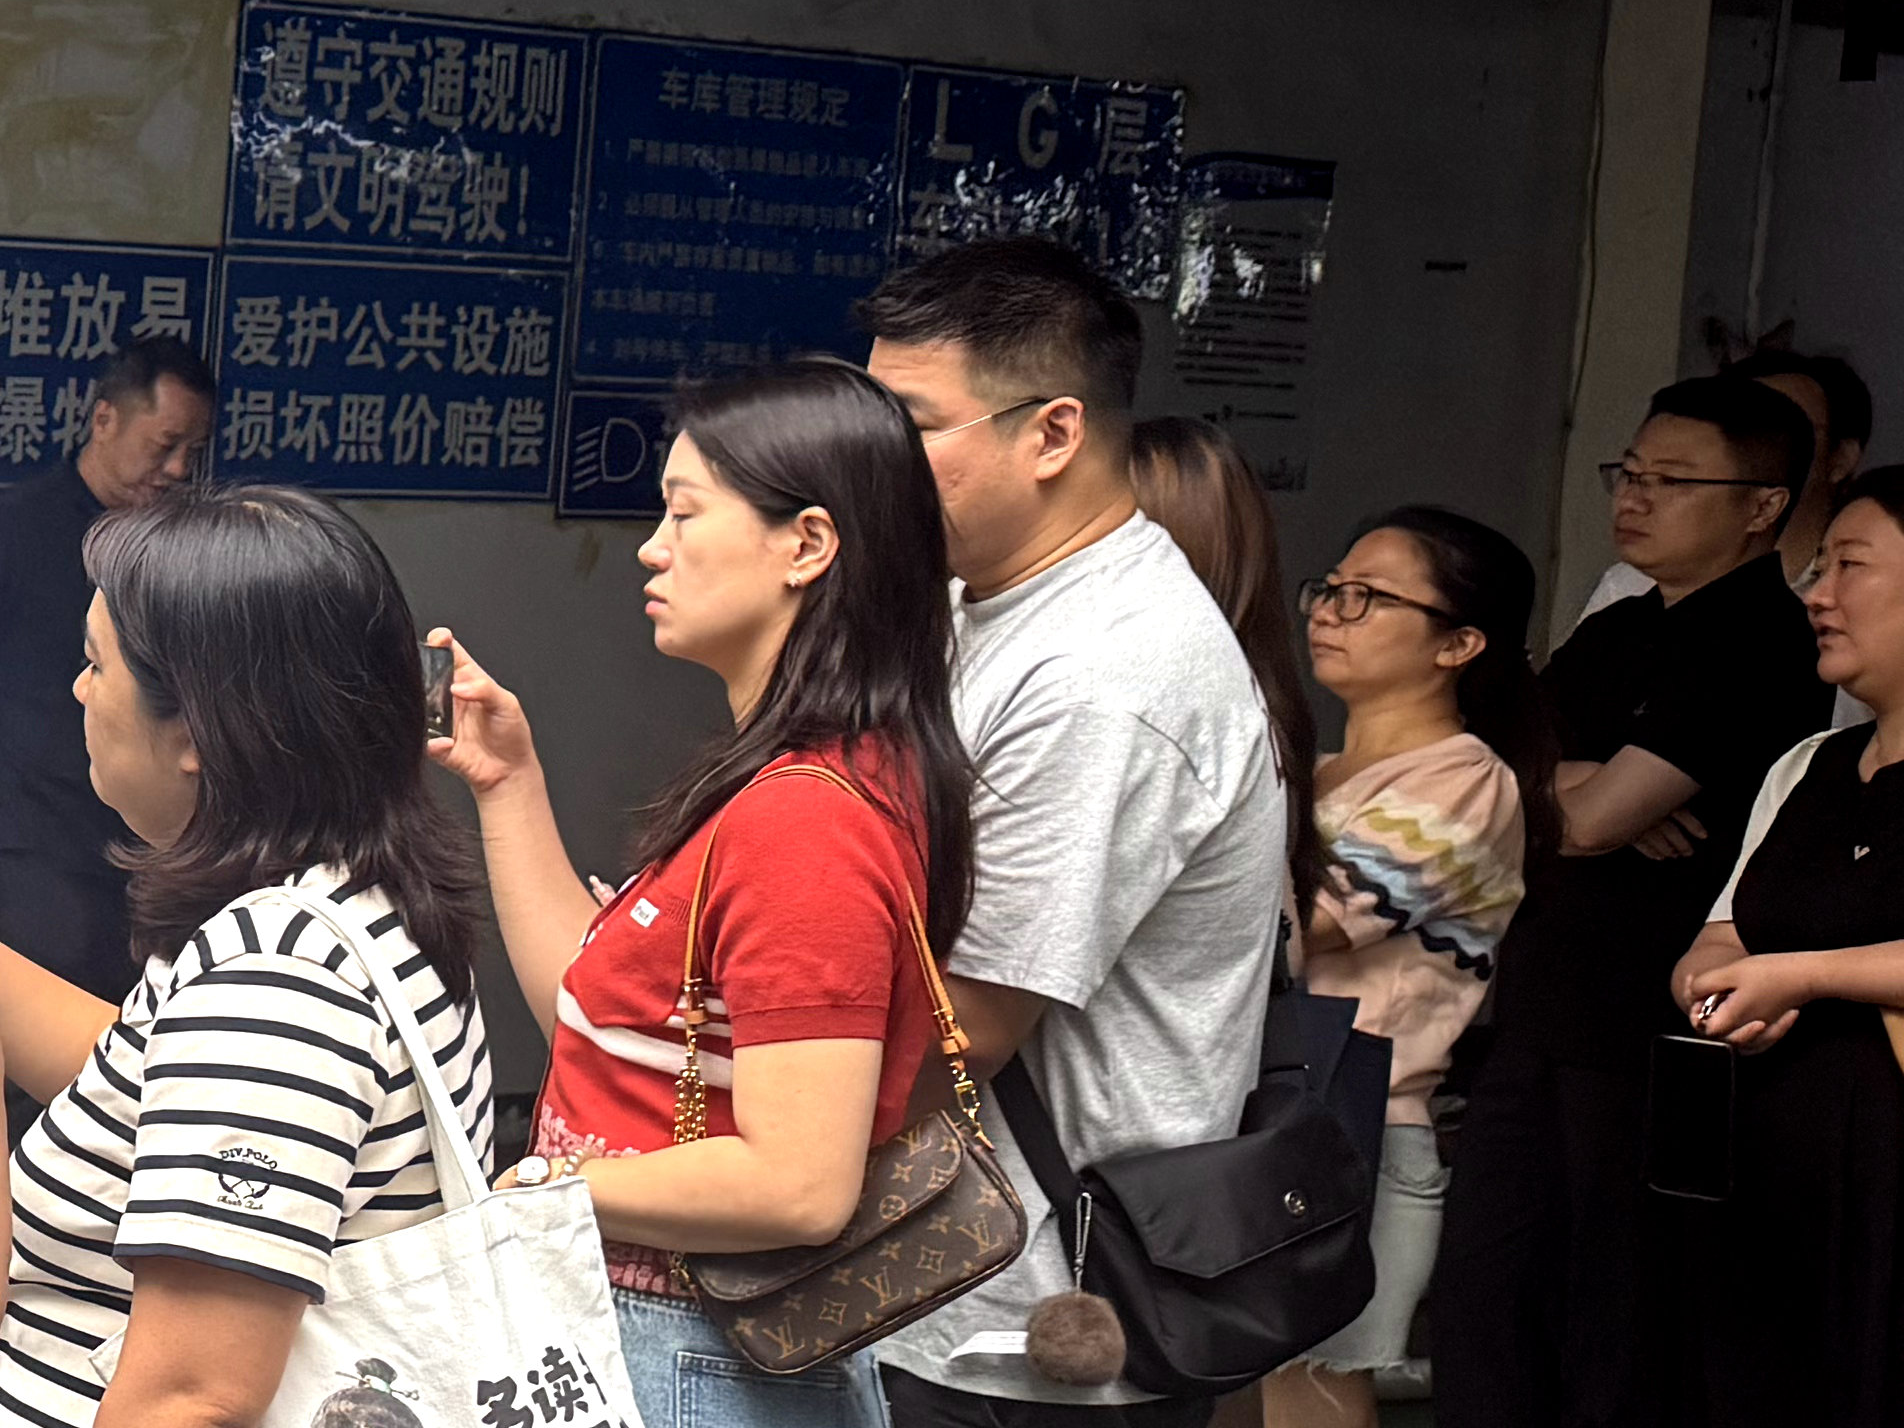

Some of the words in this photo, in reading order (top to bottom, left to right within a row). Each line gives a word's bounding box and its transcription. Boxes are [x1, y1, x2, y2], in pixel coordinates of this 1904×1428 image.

[259, 16, 569, 137] 遵守交通规则
[657, 64, 850, 129] 车库管理规定
[231, 294, 555, 379] 爱护公共设施
[223, 387, 547, 470] 损坏照价赔偿
